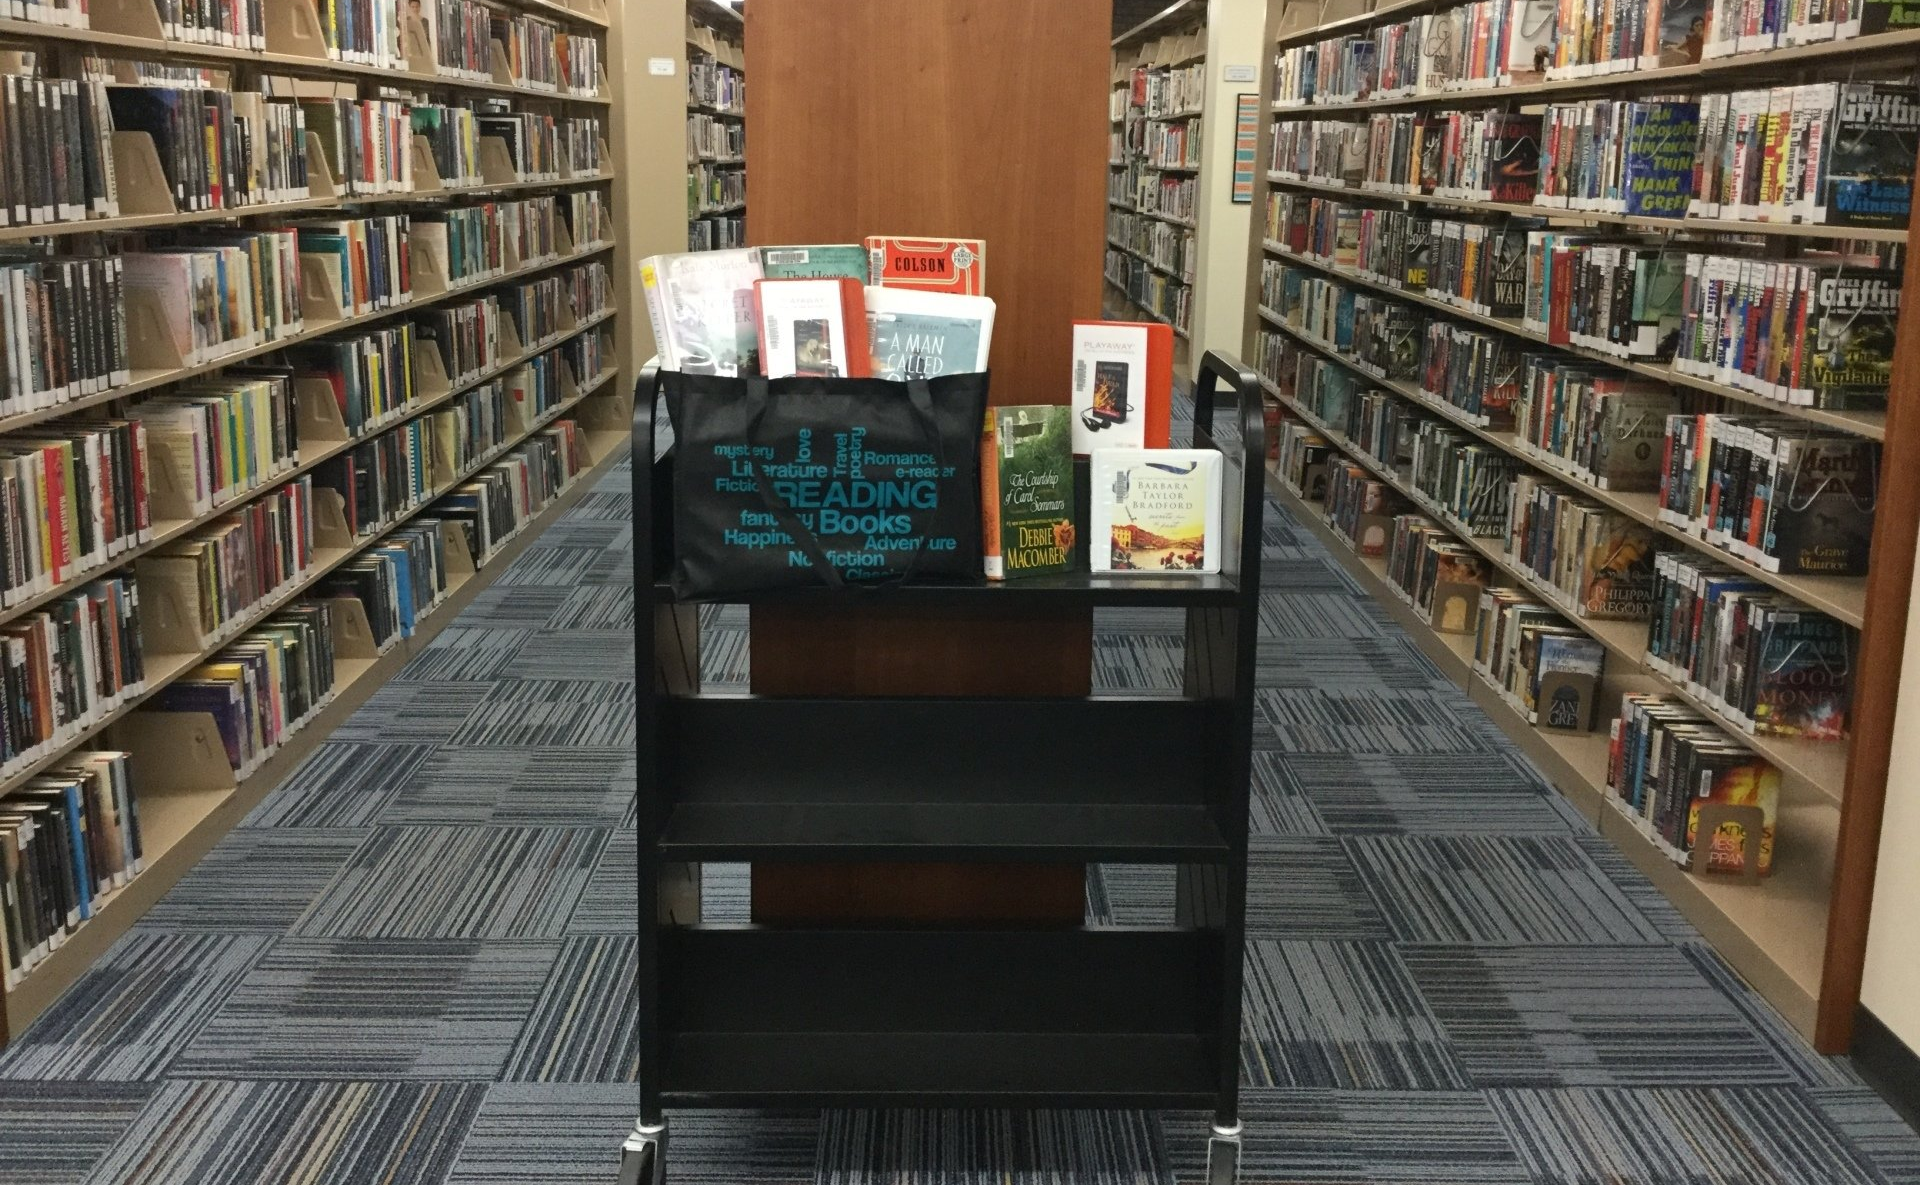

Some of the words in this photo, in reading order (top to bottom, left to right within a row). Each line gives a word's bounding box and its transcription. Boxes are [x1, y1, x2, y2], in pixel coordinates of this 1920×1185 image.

[1653, 155, 1694, 171] THIN
[1632, 177, 1681, 193] HANK
[895, 257, 946, 273] COLSON
[1495, 281, 1524, 304] WAR
[890, 332, 900, 351] A
[905, 333, 945, 355] MAN
[1083, 341, 1133, 350] PLAYAWAY
[887, 353, 944, 375] CALLED
[1493, 387, 1518, 400] KILL
[714, 444, 774, 459] mystery
[795, 427, 812, 463] love
[849, 426, 867, 479] poetry
[832, 433, 848, 477] Travel
[864, 451, 936, 466] Romance
[732, 459, 828, 478] Literature
[715, 477, 761, 492] Fictio
[1009, 473, 1025, 488] The
[1025, 469, 1059, 490] Courtship
[1138, 481, 1188, 490] BARBARA
[773, 480, 938, 509] READING
[1004, 488, 1013, 507] of
[1013, 487, 1035, 505] Carol
[1142, 491, 1184, 500] TAYLOR
[1030, 495, 1065, 513] Sommars
[1132, 501, 1193, 510] BRADFORD
[740, 509, 814, 531] fanty
[820, 508, 912, 535] Books
[1019, 527, 1053, 549] DEBBIE
[789, 549, 885, 568] Nofiction
[1007, 546, 1067, 570] MACOMBER
[1813, 546, 1849, 557] Grave
[1798, 556, 1848, 570] Maurice
[1595, 586, 1649, 600] PHILIPPA
[1587, 600, 1652, 614] GREGORY
[1548, 711, 1576, 726] GRE
